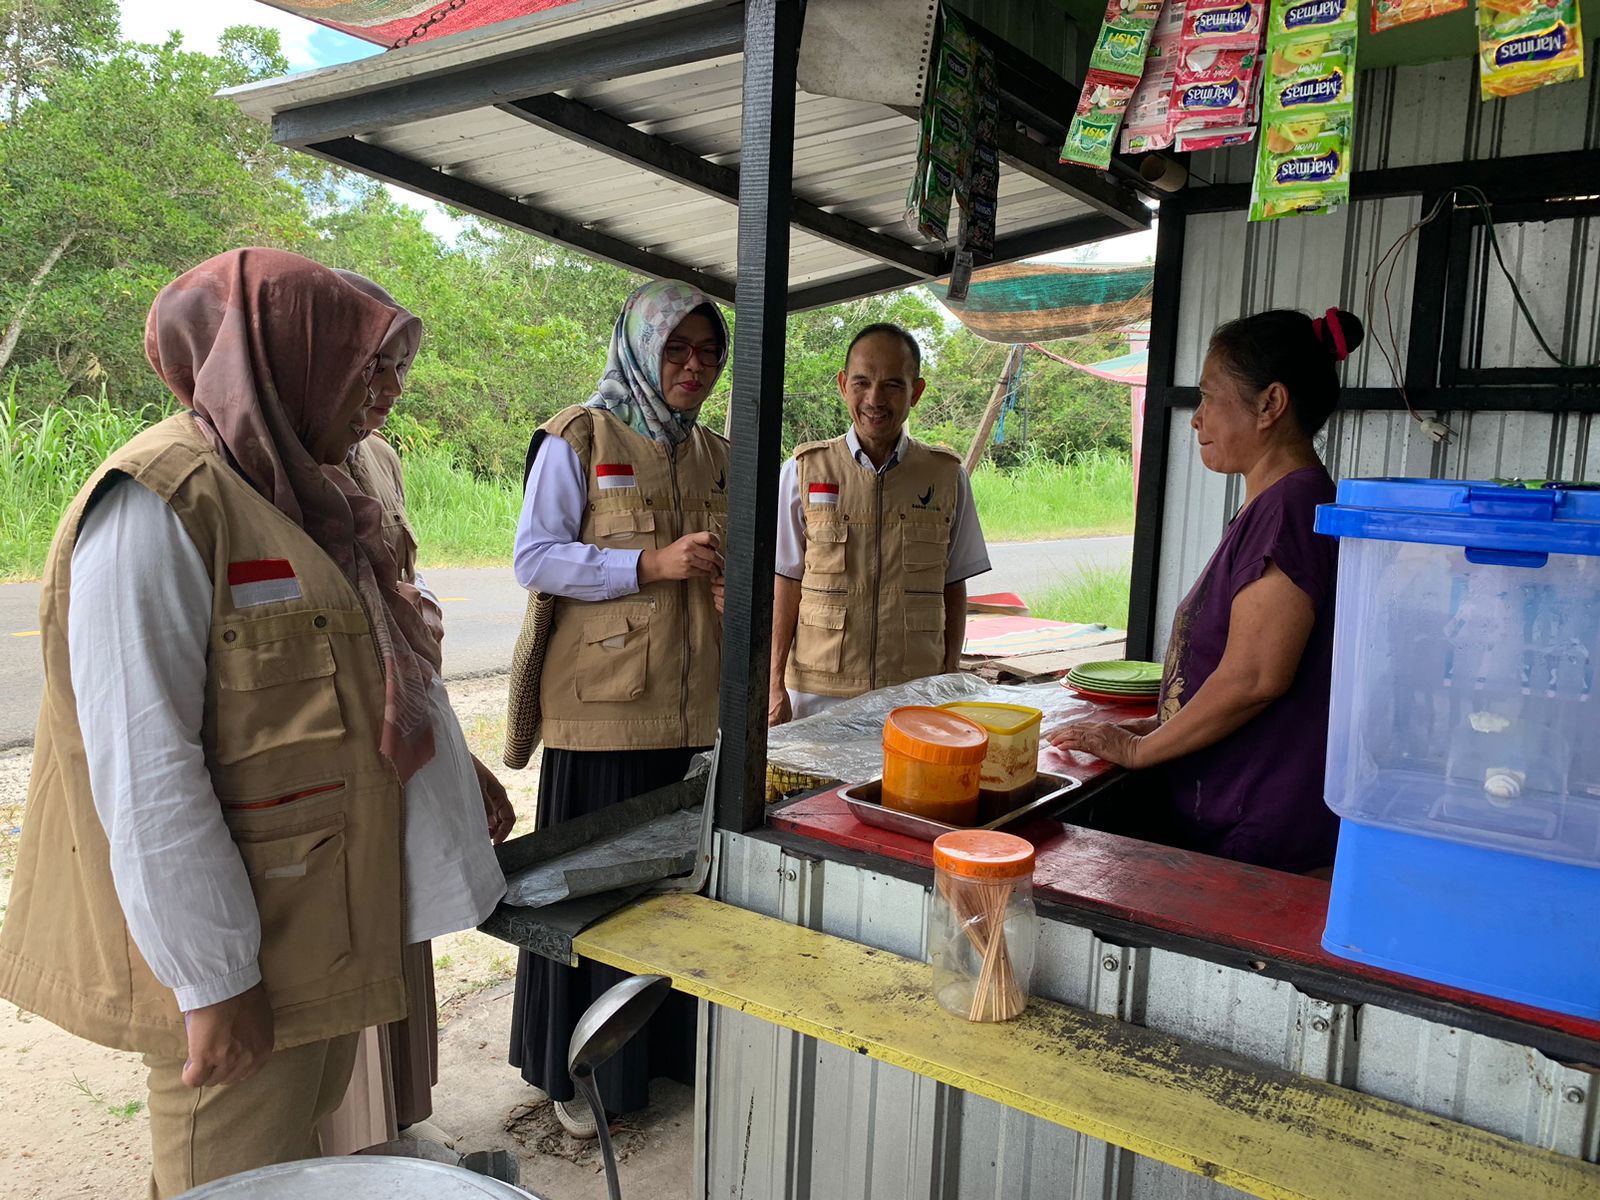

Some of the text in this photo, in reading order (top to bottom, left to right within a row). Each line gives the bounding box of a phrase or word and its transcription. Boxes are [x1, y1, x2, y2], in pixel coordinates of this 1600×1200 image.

[1200, 11, 1247, 26] Marimas
[1289, 0, 1340, 20] Marimas
[1108, 31, 1138, 49] Sisri
[1501, 34, 1561, 58] Marimas
[1188, 86, 1234, 100] Marimas
[1286, 80, 1337, 99] Marimas
[1294, 142, 1321, 151] Melon
[1282, 159, 1333, 176] Marimas
